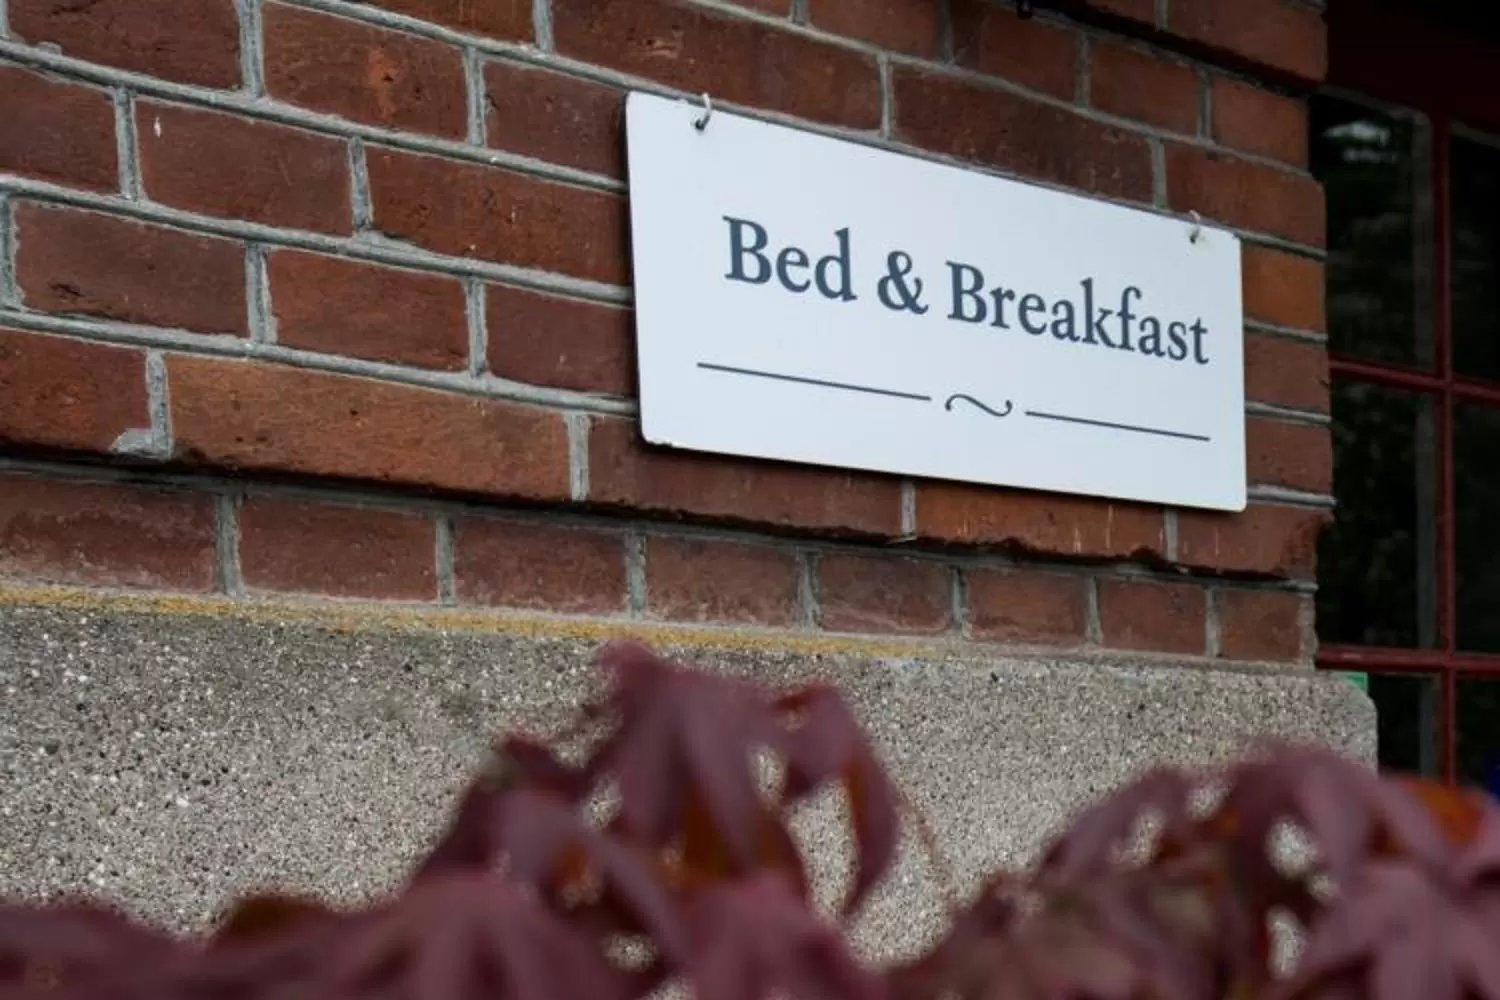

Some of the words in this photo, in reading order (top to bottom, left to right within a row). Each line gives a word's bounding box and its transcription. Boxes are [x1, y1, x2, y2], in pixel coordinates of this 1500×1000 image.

[722, 215, 858, 302] Bed
[877, 250, 929, 315] &
[945, 260, 1210, 365] Breakfast
